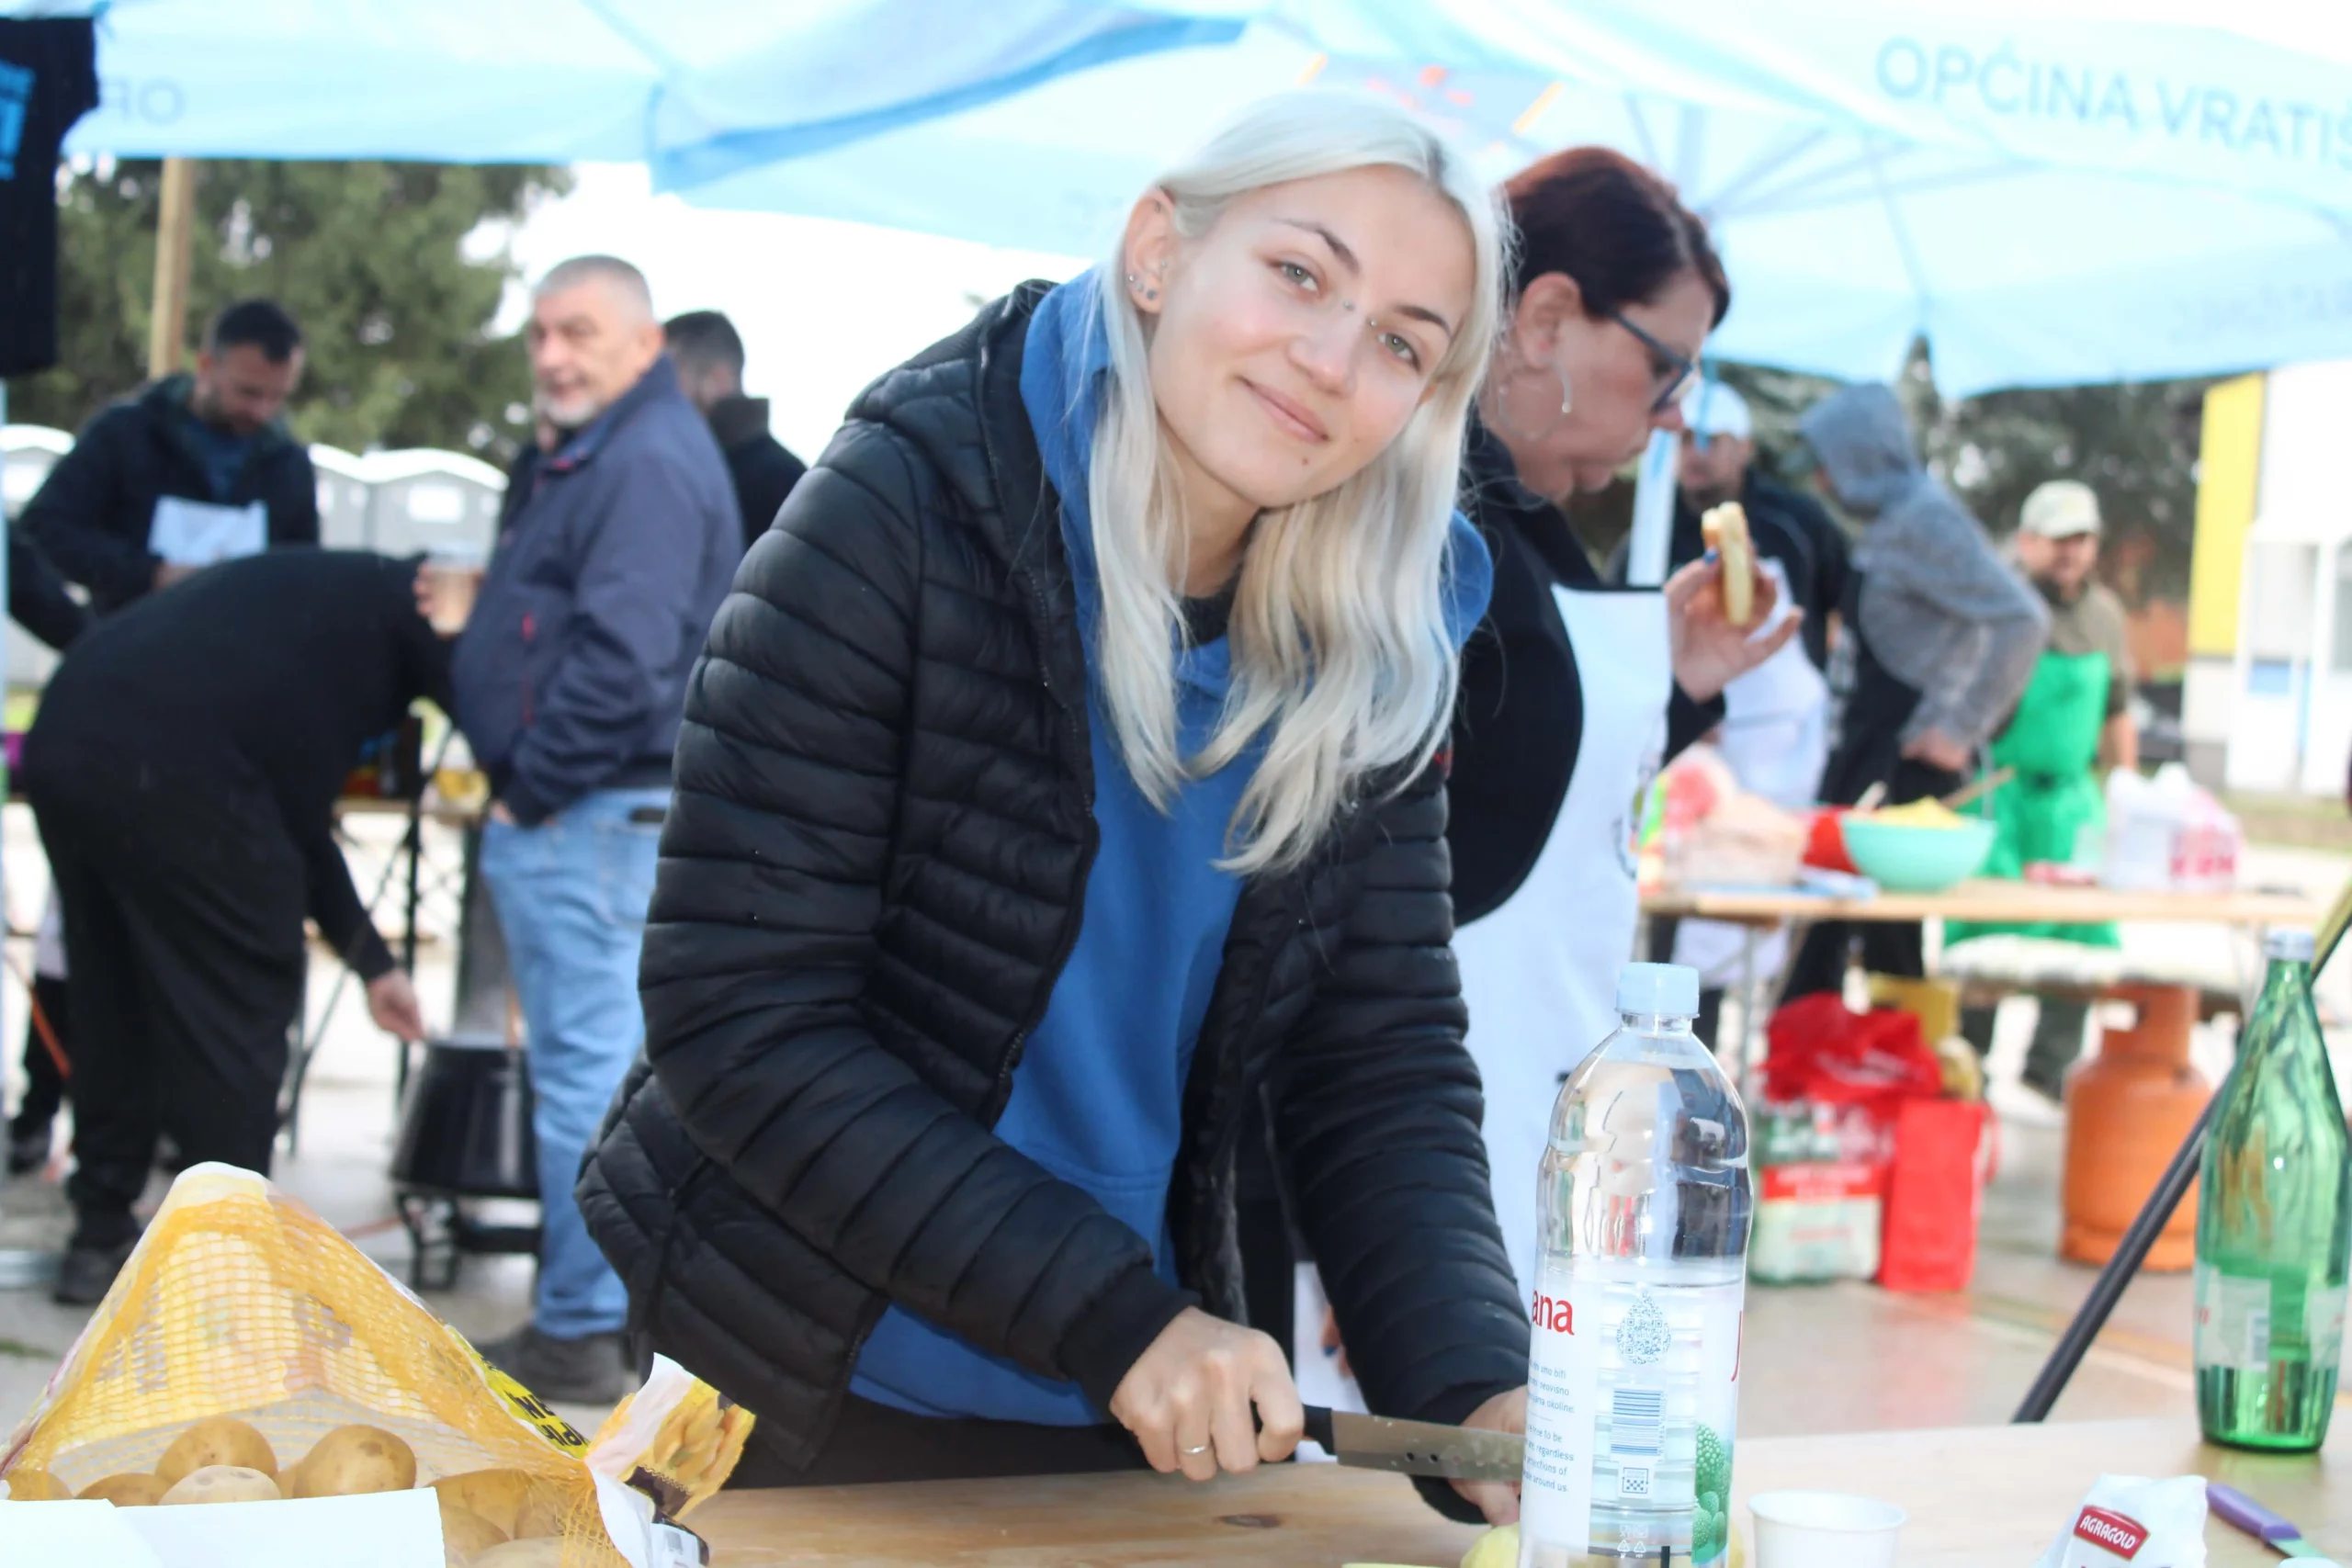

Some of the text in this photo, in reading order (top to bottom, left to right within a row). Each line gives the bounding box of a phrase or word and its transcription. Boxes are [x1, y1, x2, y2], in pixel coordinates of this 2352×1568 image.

[1875, 37, 2139, 130] OPĆINA
[1532, 1290, 1575, 1336] ana
[1553, 1431, 1563, 1443] be
[1536, 1445, 1575, 1461] regardless
[1558, 1466, 1568, 1476] of
[1532, 1475, 1555, 1490] around
[2079, 1515, 2136, 1550] AGRAGOLD
